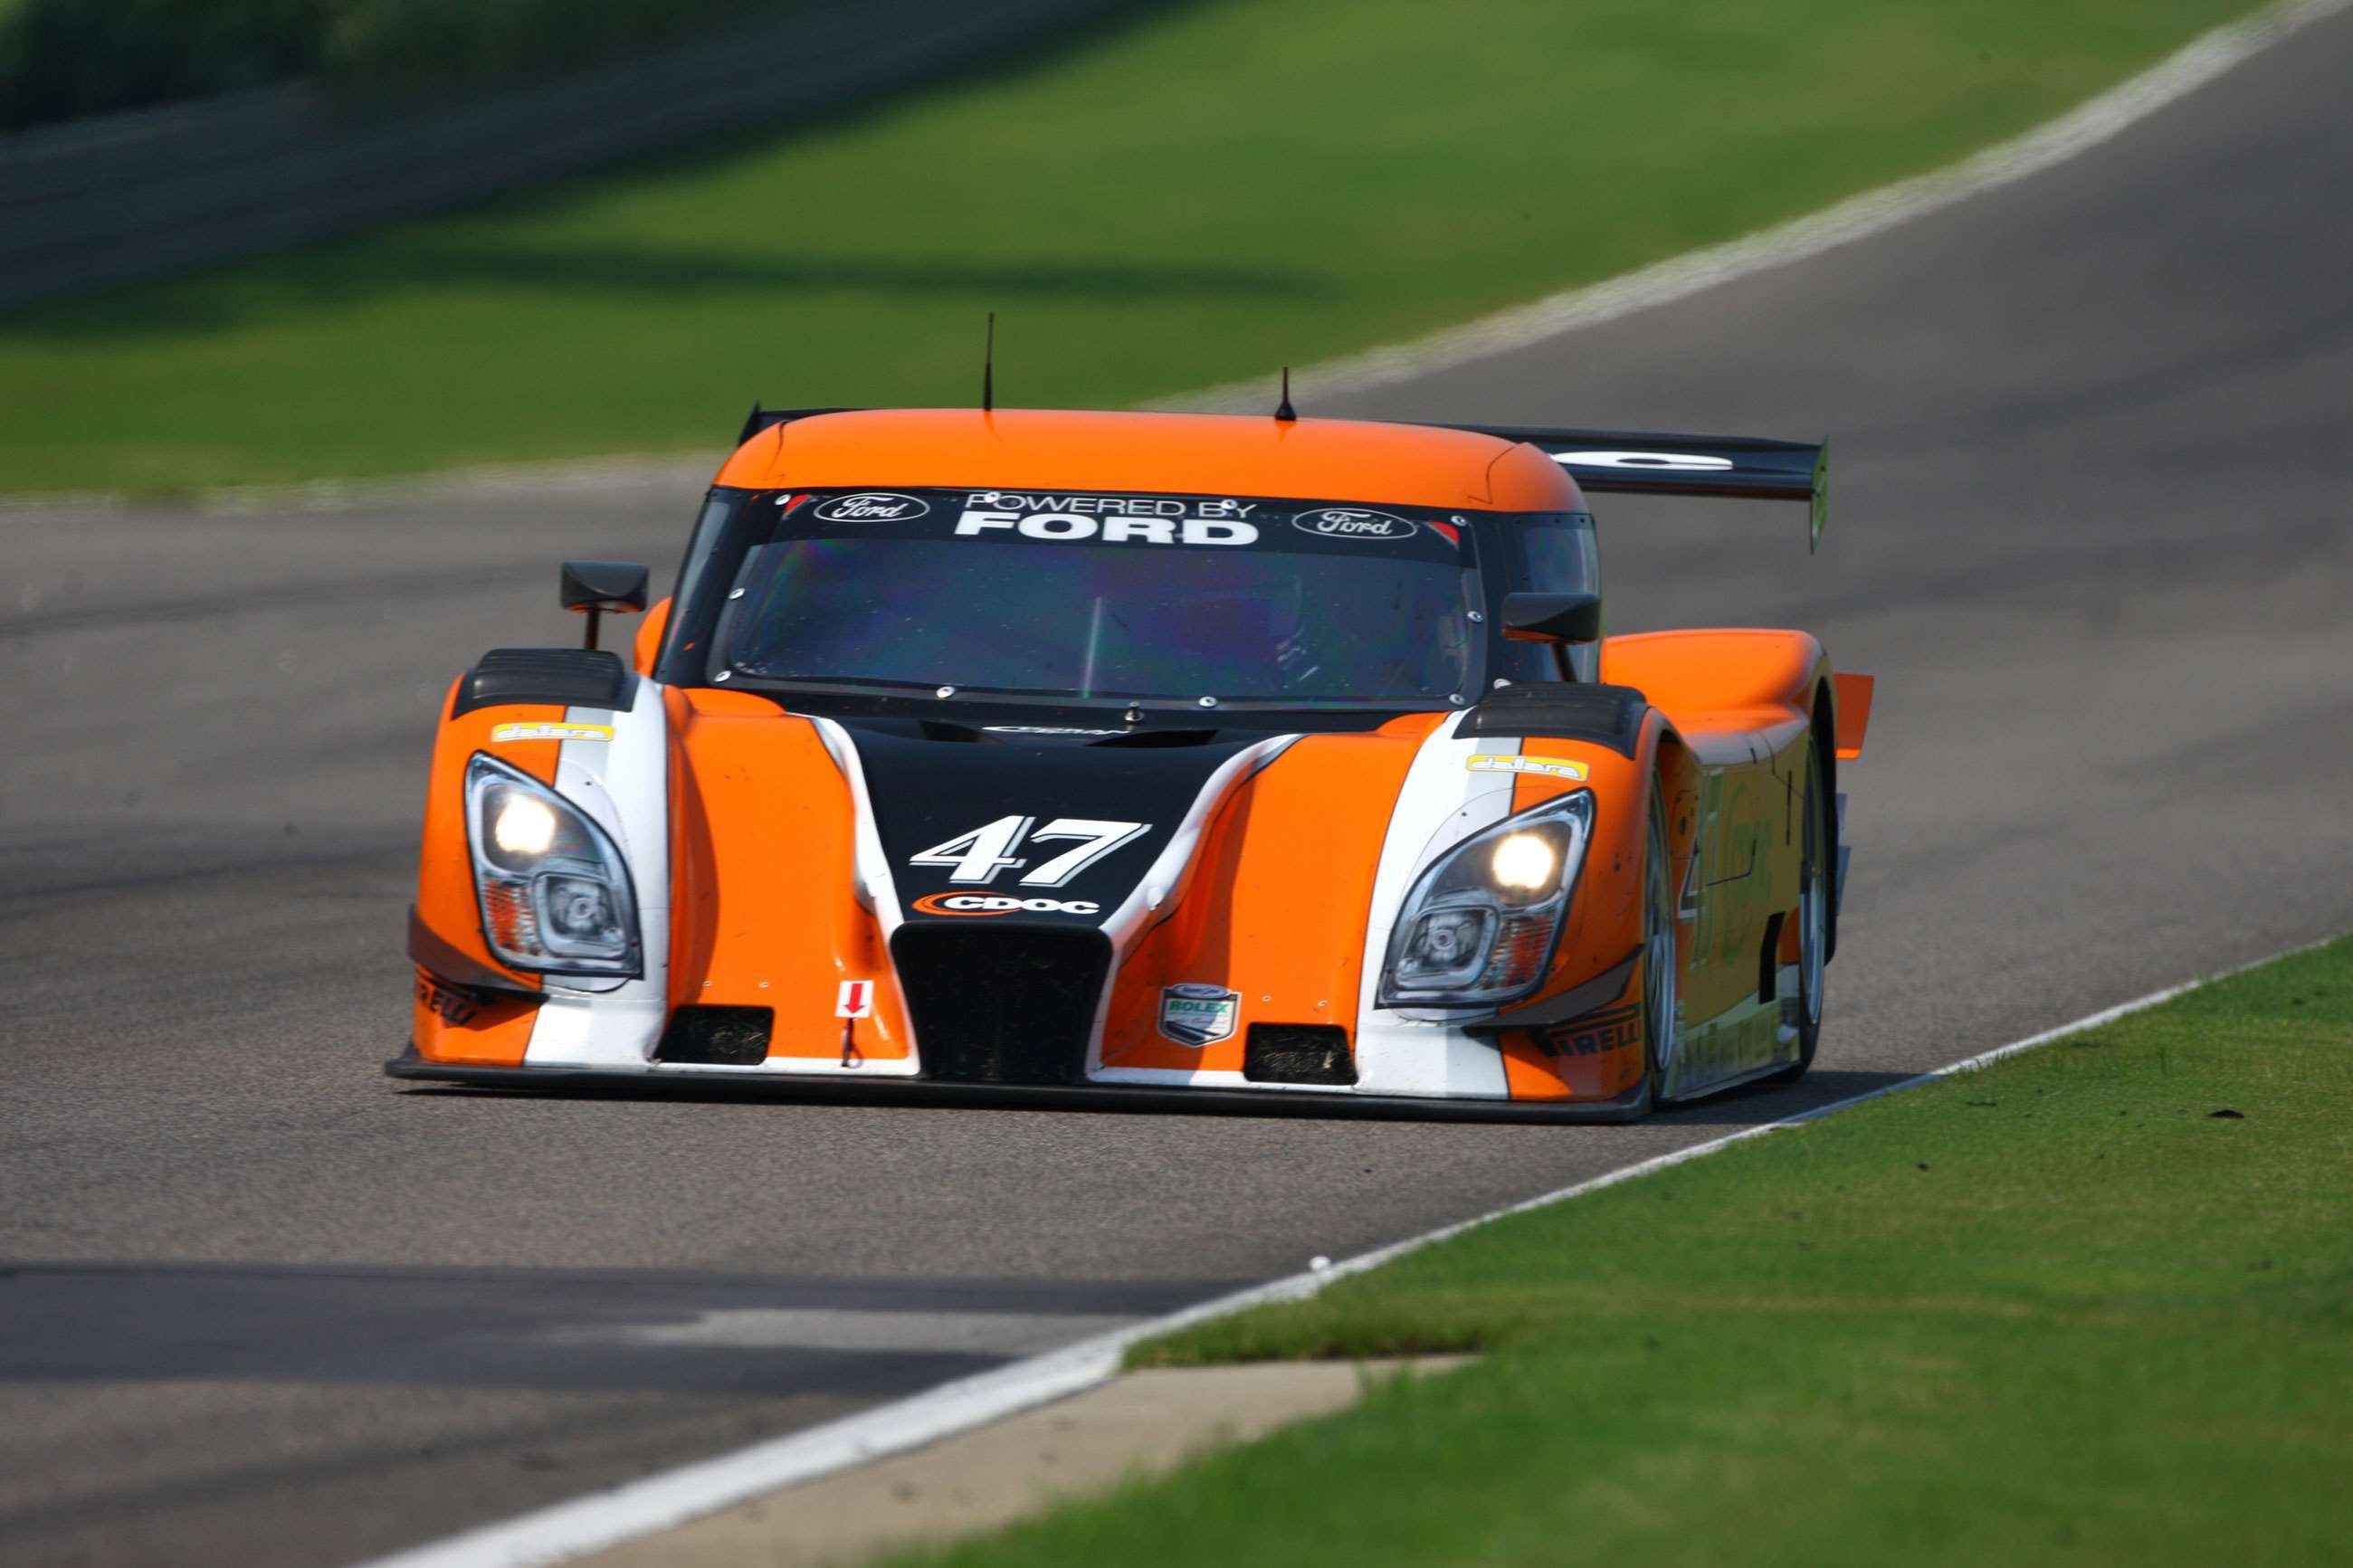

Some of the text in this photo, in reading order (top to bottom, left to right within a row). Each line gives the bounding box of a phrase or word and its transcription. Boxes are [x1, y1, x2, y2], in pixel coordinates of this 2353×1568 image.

[831, 496, 909, 518] Ford
[965, 491, 1258, 518] POWERED BY
[954, 510, 1260, 546] FORD
[1317, 510, 1393, 537] Ford
[909, 814, 1153, 888] 47
[944, 896, 1100, 915] CDOC
[1168, 1000, 1229, 1013] ROLEX
